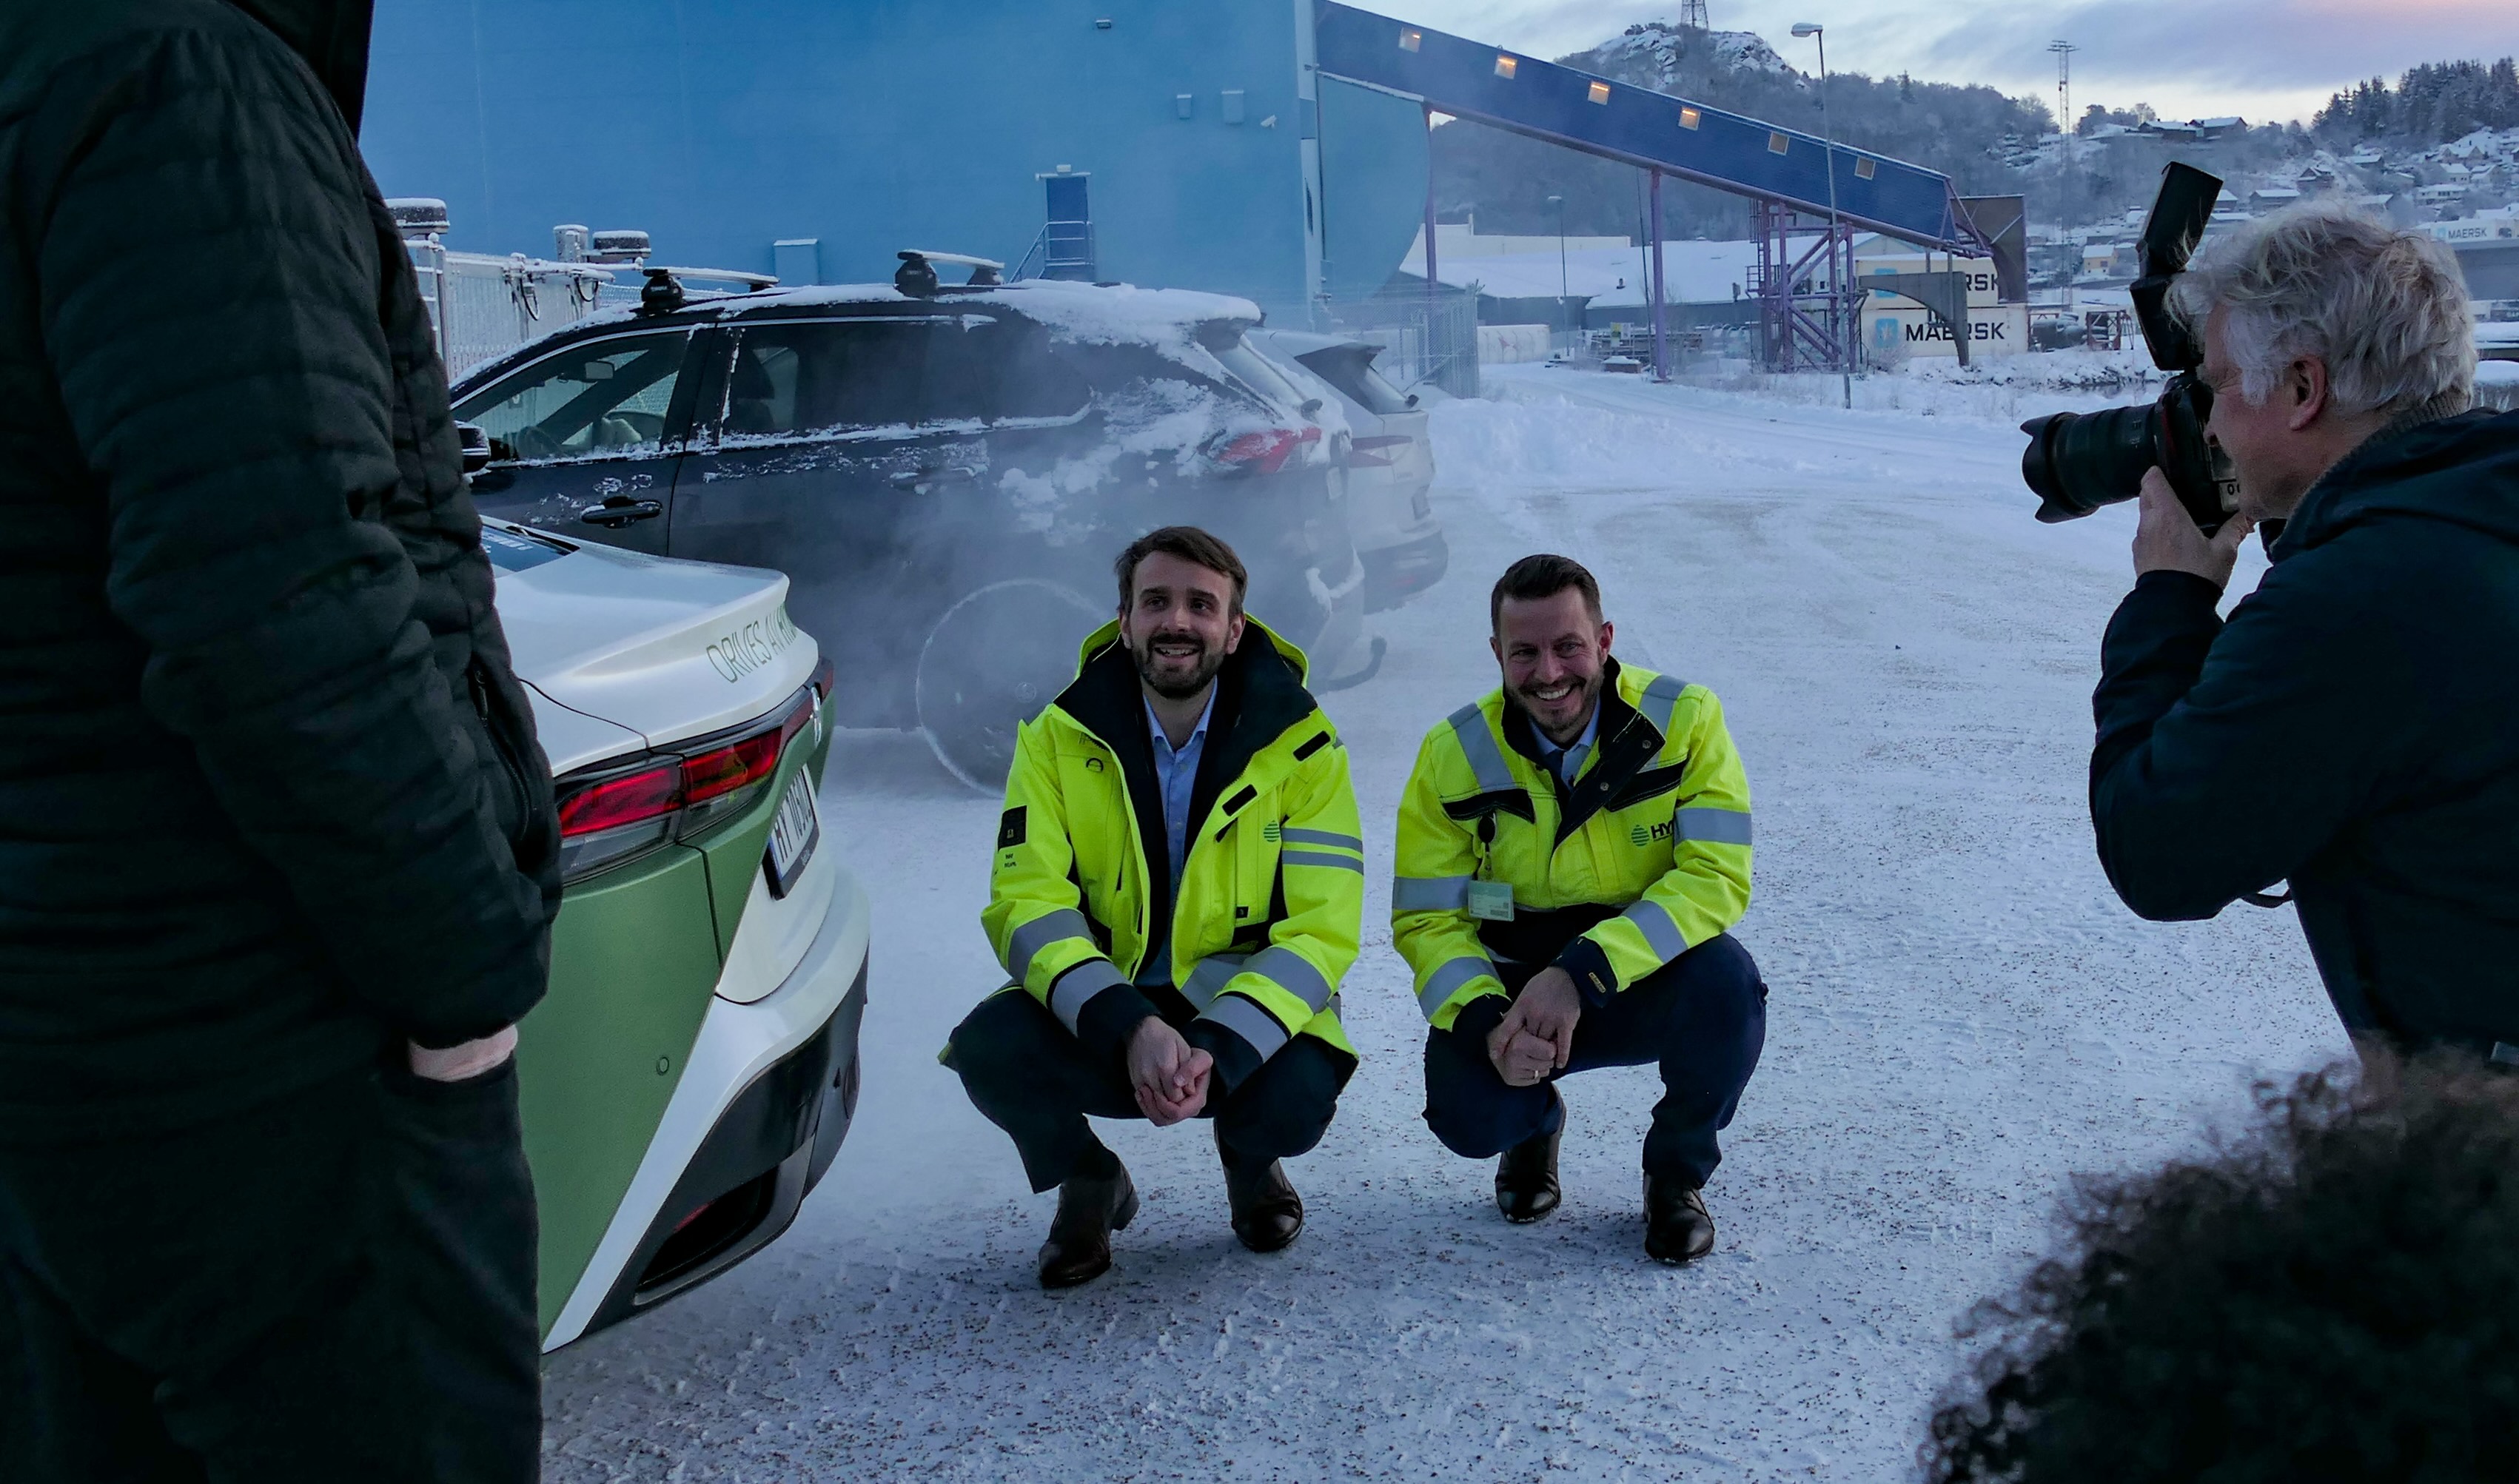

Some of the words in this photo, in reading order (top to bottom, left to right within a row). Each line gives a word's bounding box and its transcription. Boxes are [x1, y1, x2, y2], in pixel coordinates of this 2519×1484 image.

[2447, 227, 2487, 238] MAERSK
[706, 620, 772, 683] DRIVES
[1651, 819, 1674, 839] HY
